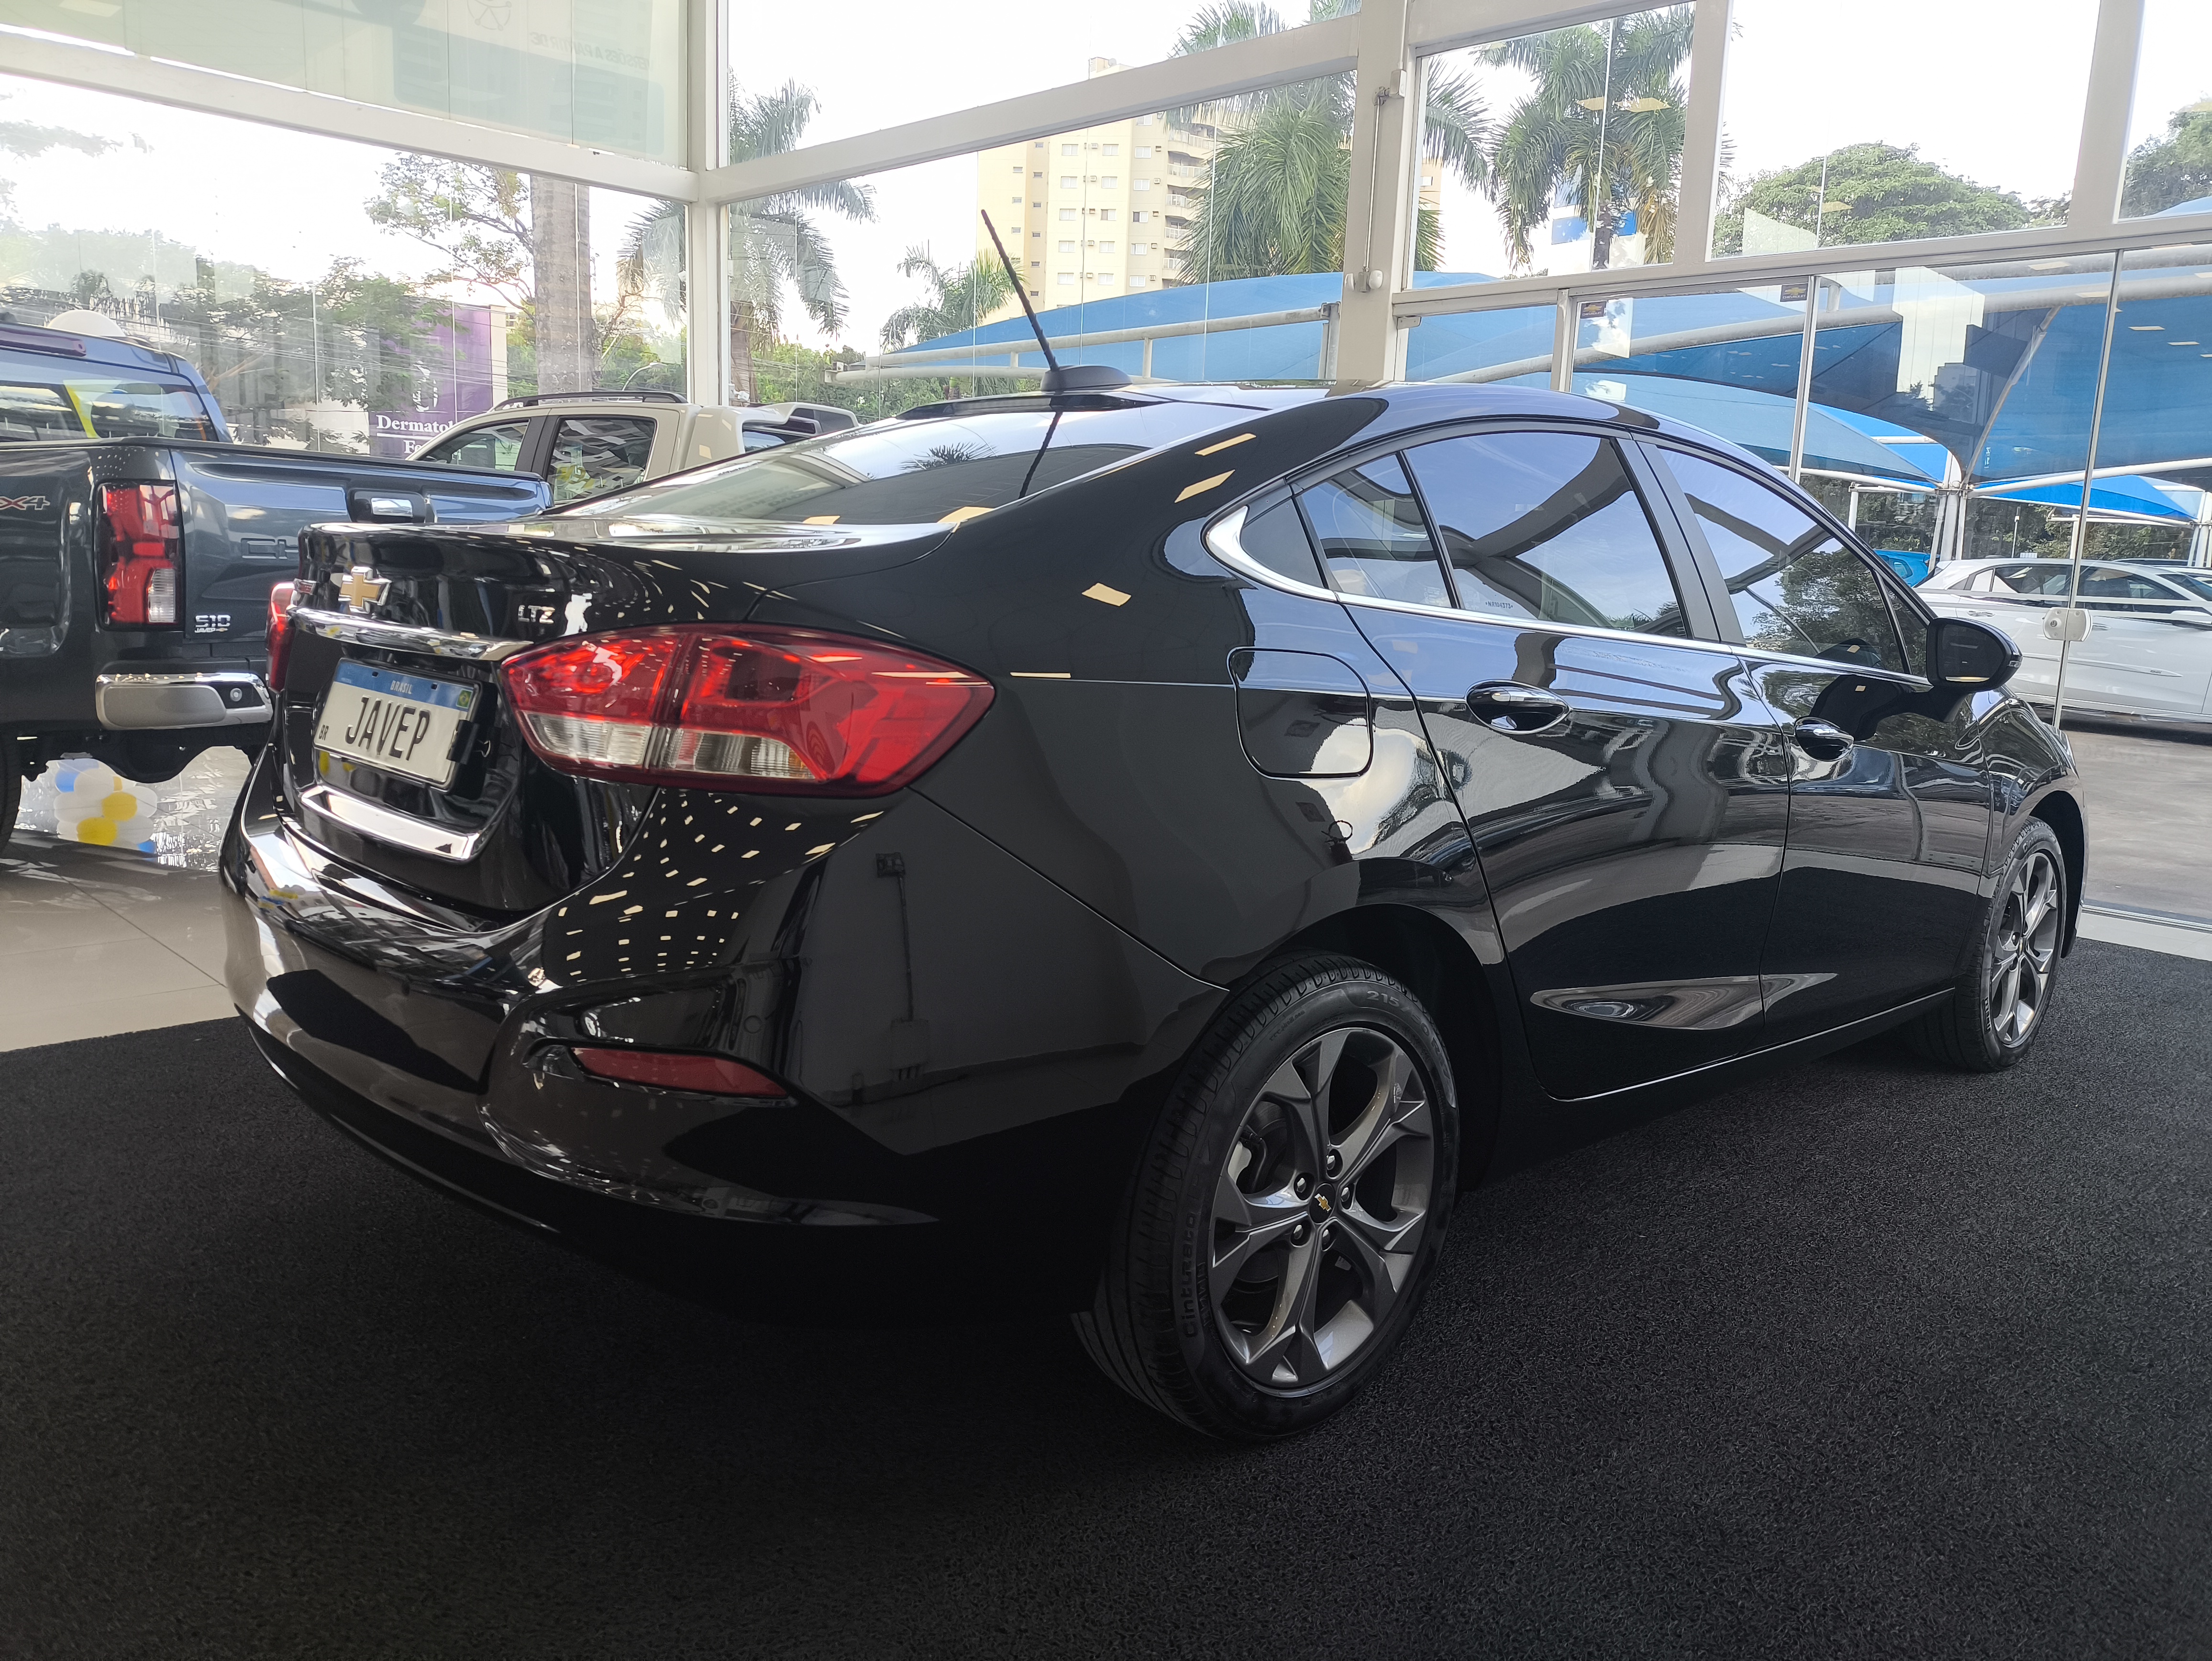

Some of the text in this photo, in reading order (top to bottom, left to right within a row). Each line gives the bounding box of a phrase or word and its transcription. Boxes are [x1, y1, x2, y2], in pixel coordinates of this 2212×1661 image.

[376, 415, 453, 433] Dermatol
[195, 615, 231, 627] S10
[518, 605, 555, 624] LTZ
[390, 680, 413, 695] BRASIL
[318, 724, 329, 741] BR
[344, 695, 431, 761] JAVEP
[1181, 1212, 1197, 1338] Cinturato
